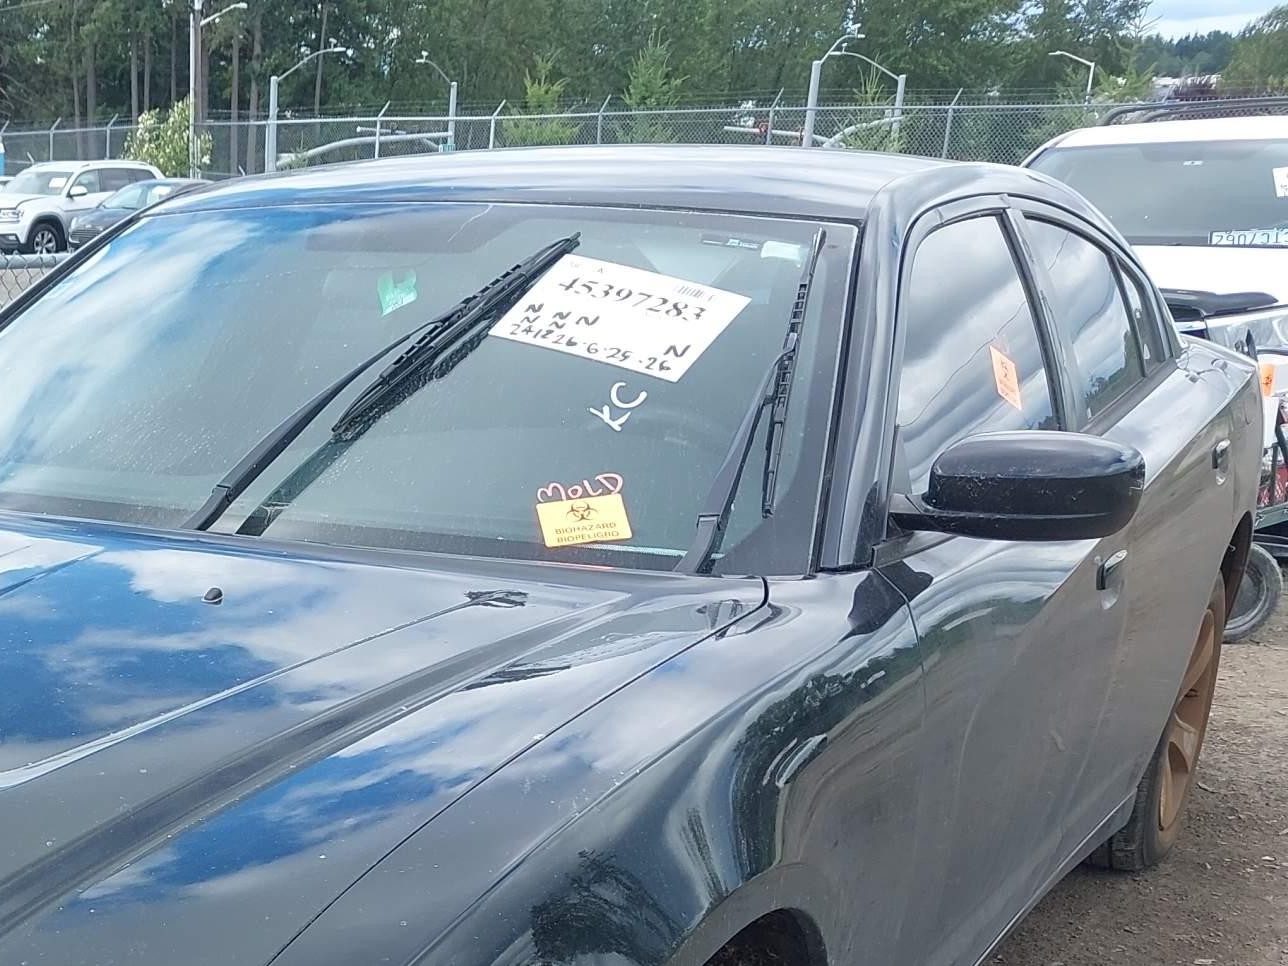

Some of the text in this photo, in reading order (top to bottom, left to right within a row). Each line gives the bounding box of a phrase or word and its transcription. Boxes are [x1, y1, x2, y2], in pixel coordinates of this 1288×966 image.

[559, 277, 708, 321] 45397283
[536, 472, 624, 502] MOLD
[554, 521, 618, 535] BIOHAZARD
[556, 530, 620, 544] BIOPELIGRO
